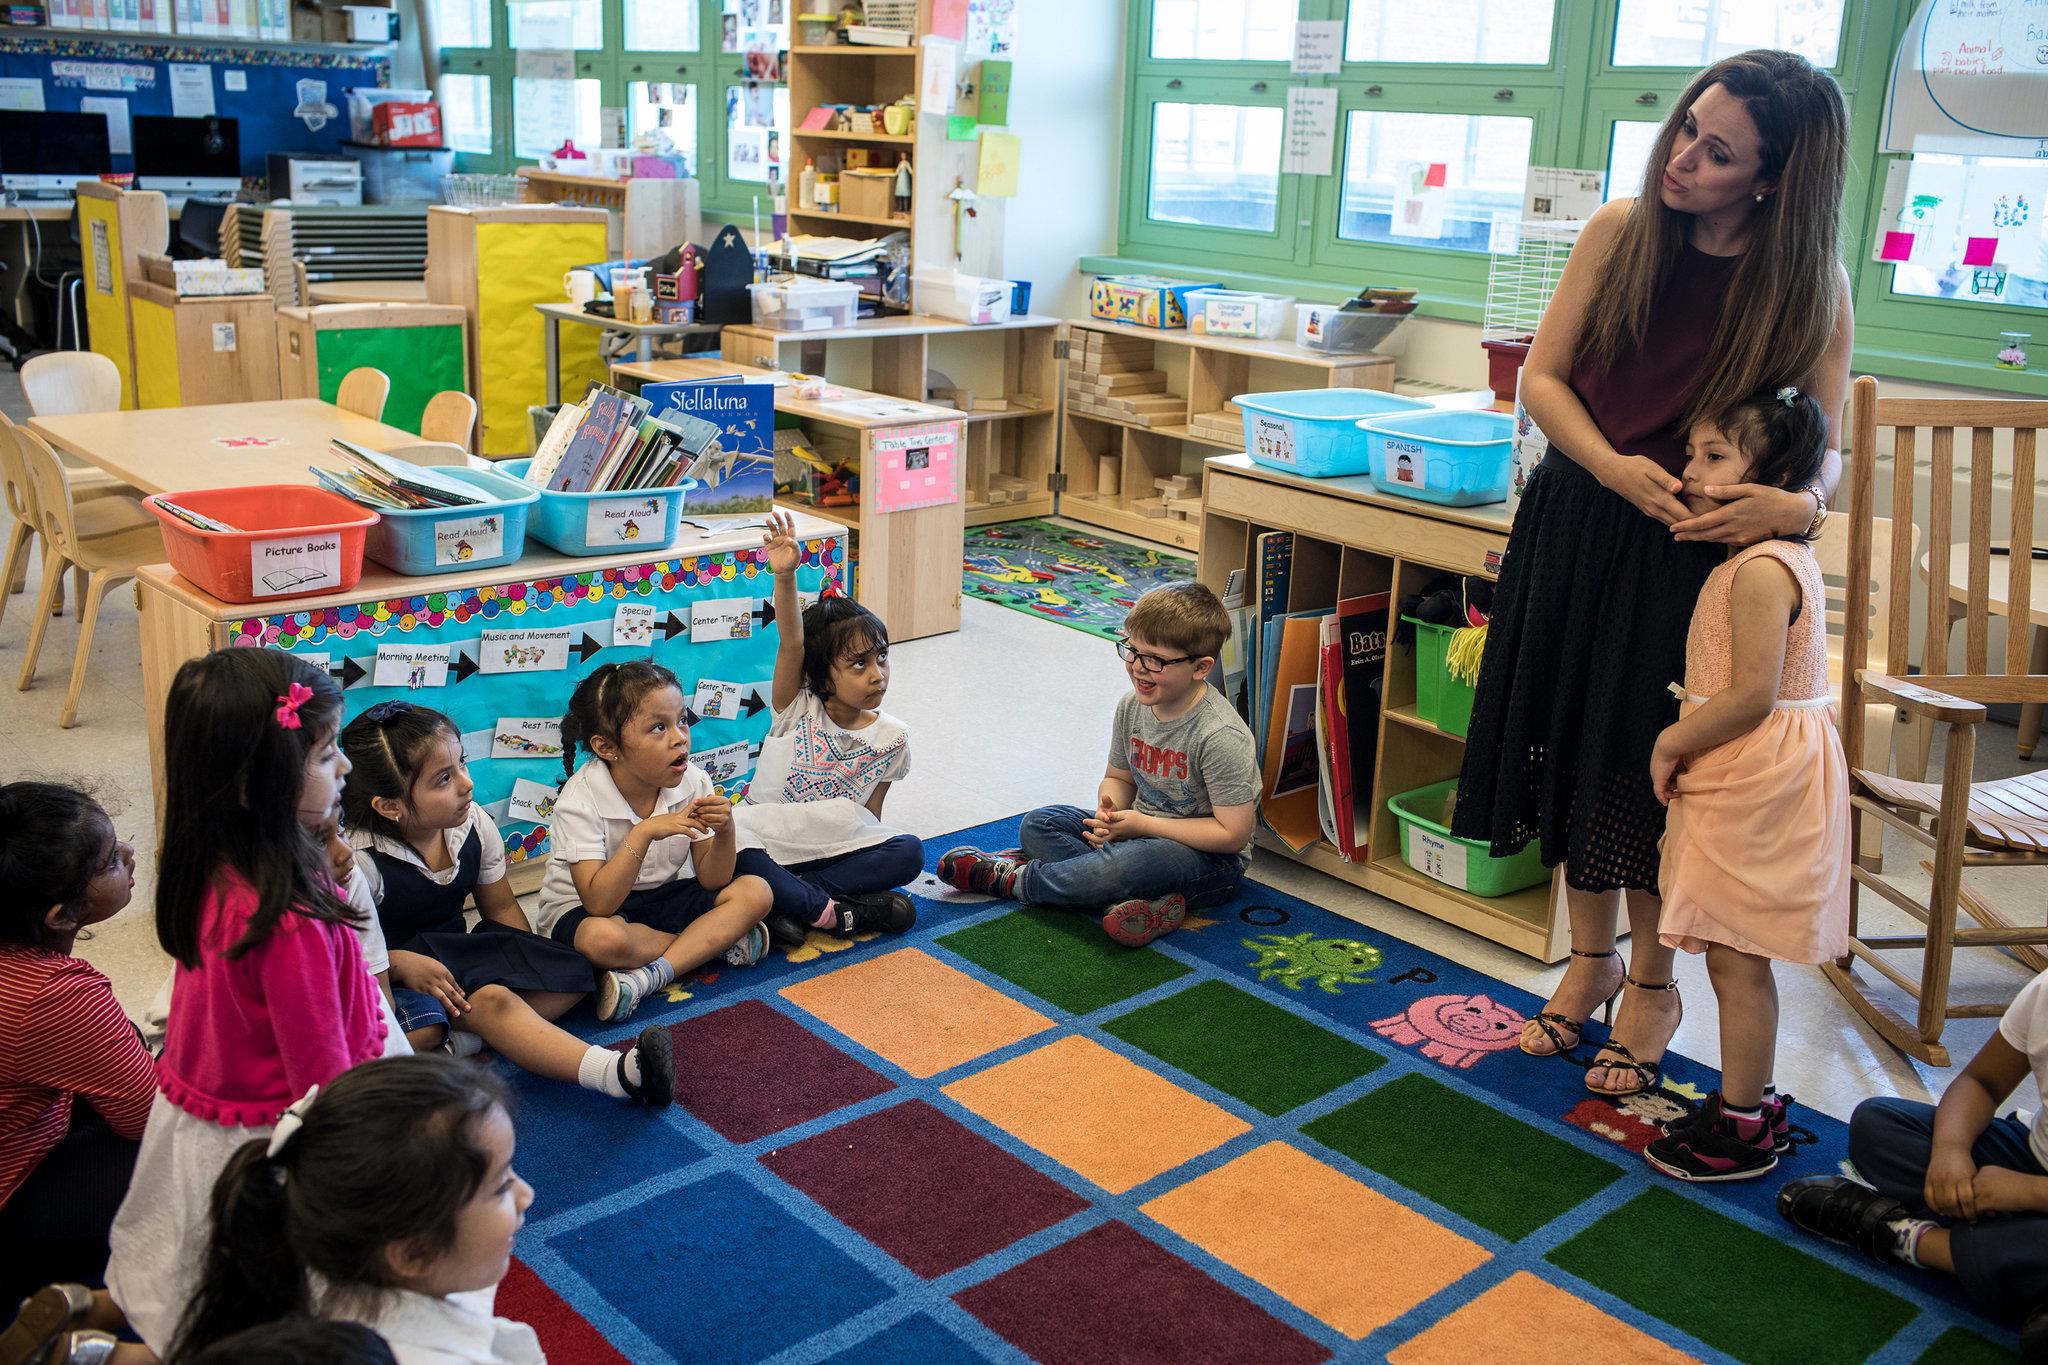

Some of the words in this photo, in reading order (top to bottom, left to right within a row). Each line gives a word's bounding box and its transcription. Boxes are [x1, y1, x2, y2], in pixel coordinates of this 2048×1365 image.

[671, 387, 747, 411] Stellaluna
[1260, 419, 1285, 431] Seasonal
[1386, 441, 1422, 454] SPANISH
[604, 510, 626, 519] Read
[628, 509, 652, 518] Aloud
[437, 530, 460, 541] Read
[463, 527, 488, 538] Aloud
[265, 546, 302, 557] Picture
[307, 541, 336, 552] Books
[621, 606, 652, 617] Special
[692, 617, 718, 626] Center
[721, 614, 739, 623] Time
[481, 632, 507, 642] Music
[508, 631, 525, 640] and
[527, 631, 570, 640] Movement
[1350, 631, 1385, 655] Bats
[377, 652, 412, 663] Morning
[414, 653, 450, 664] Meeting
[698, 681, 719, 691] Center
[721, 684, 736, 693] Time
[521, 721, 541, 729] Rest
[718, 743, 749, 757] Meeting
[511, 796, 532, 808] Snack
[1422, 834, 1445, 849] Rhyme
[1387, 967, 1438, 984] P
